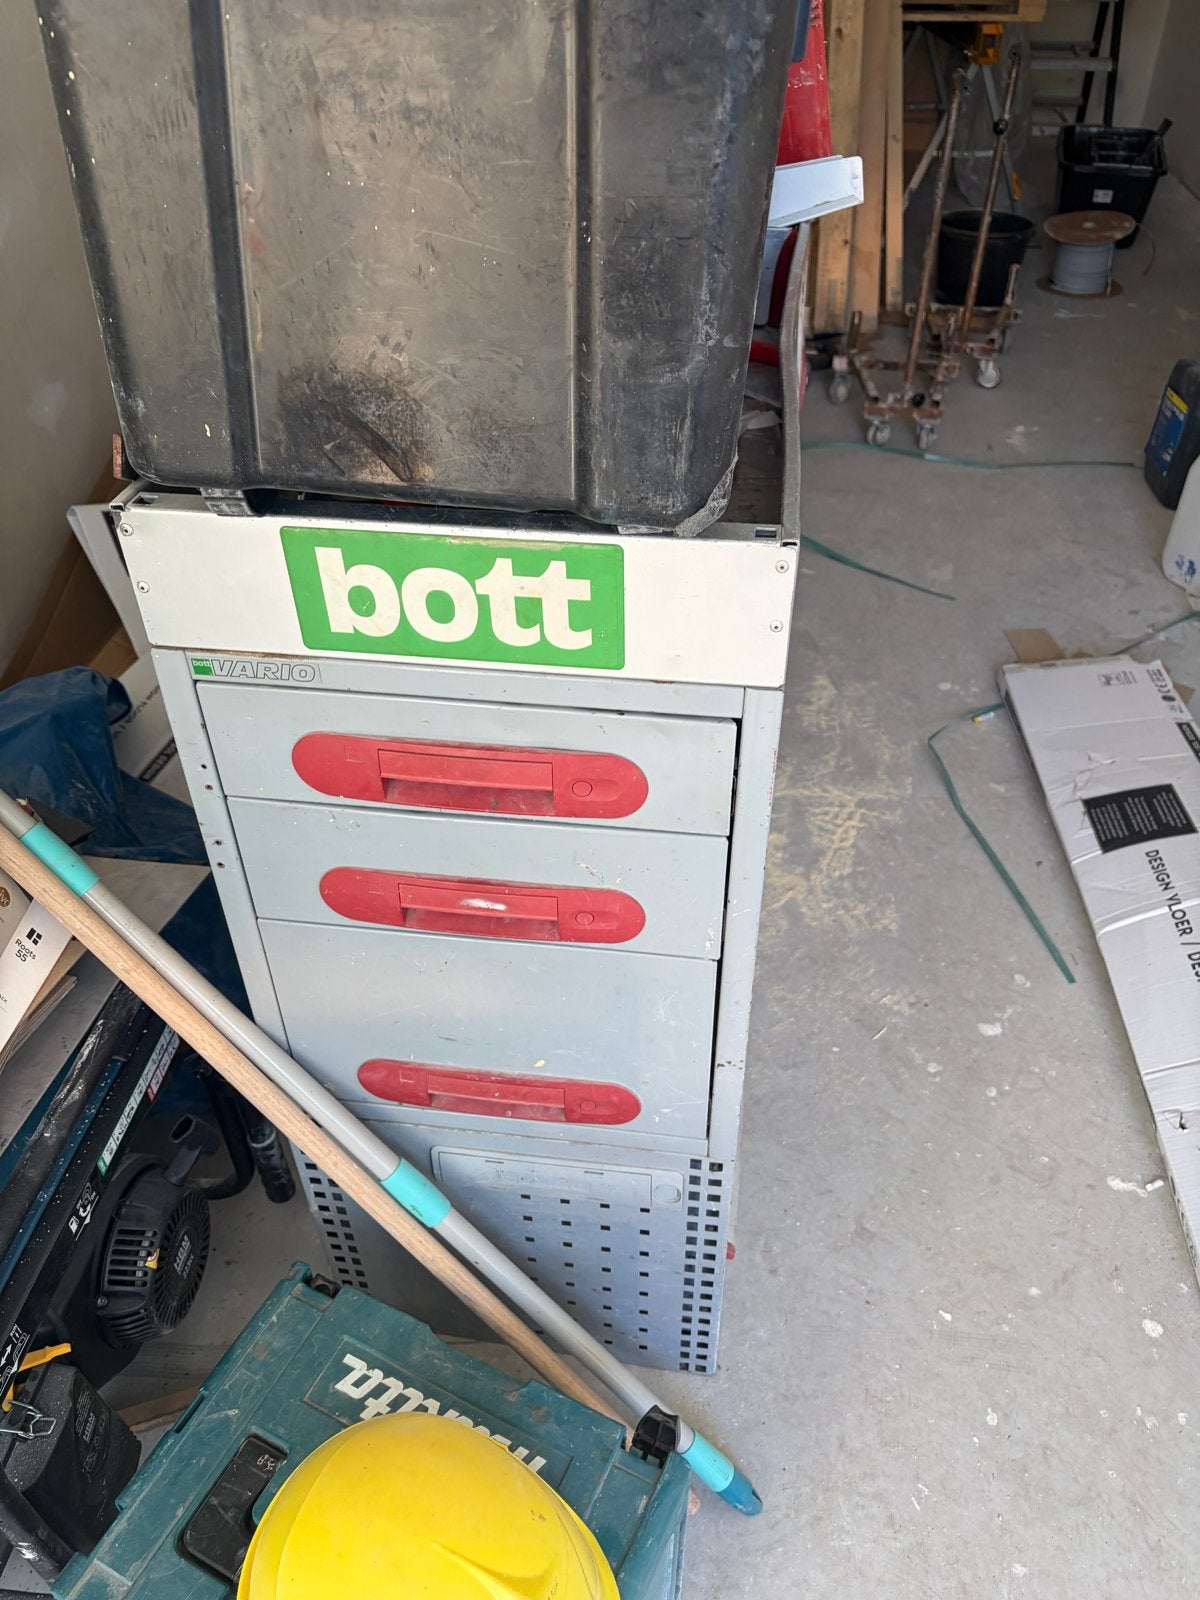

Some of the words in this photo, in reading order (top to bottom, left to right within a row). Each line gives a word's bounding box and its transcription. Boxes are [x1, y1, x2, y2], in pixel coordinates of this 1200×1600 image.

[313, 546, 593, 650] bott
[191, 659, 212, 668] bott
[211, 659, 316, 682] VARIO
[1144, 849, 1176, 892] DESIGN
[1166, 893, 1194, 938] VLOER
[14, 938, 37, 961] Roots
[15, 950, 29, 962] 55
